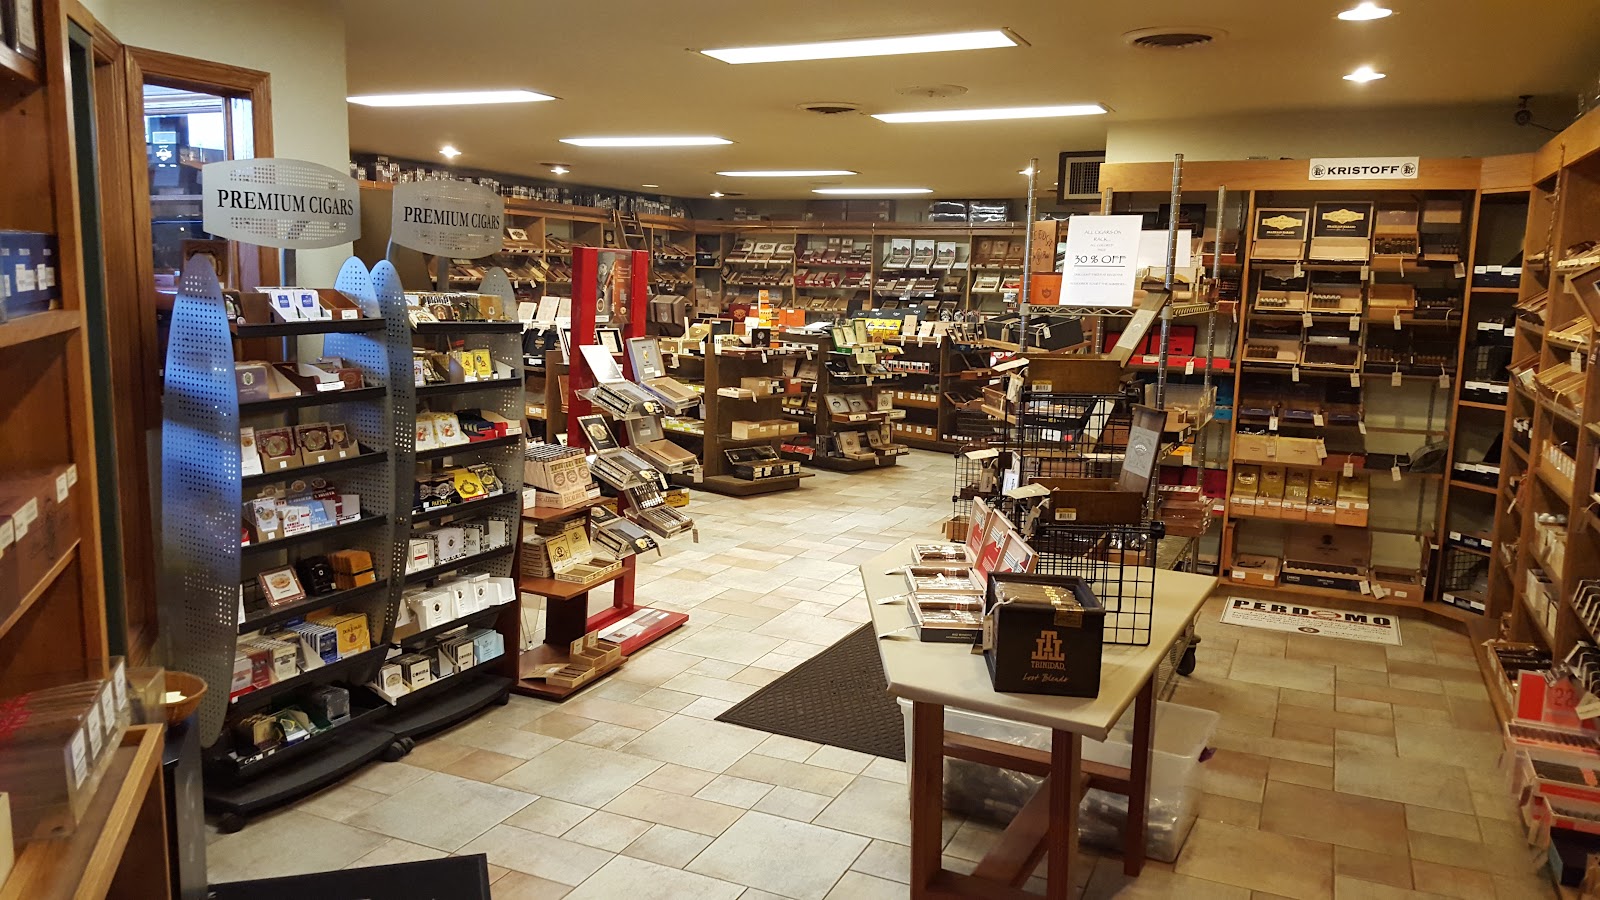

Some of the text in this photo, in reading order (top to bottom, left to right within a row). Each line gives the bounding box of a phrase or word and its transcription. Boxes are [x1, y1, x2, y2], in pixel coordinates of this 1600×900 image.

[1327, 165, 1400, 175] KRISTOFF
[216, 188, 354, 216] PREMIUM CIGARS
[403, 206, 501, 231] PREMIUM CIGARS
[1074, 254, 1127, 265] 30 % OFF
[1232, 599, 1392, 627] PERDOMO
[1031, 660, 1065, 670] TRINIDAD
